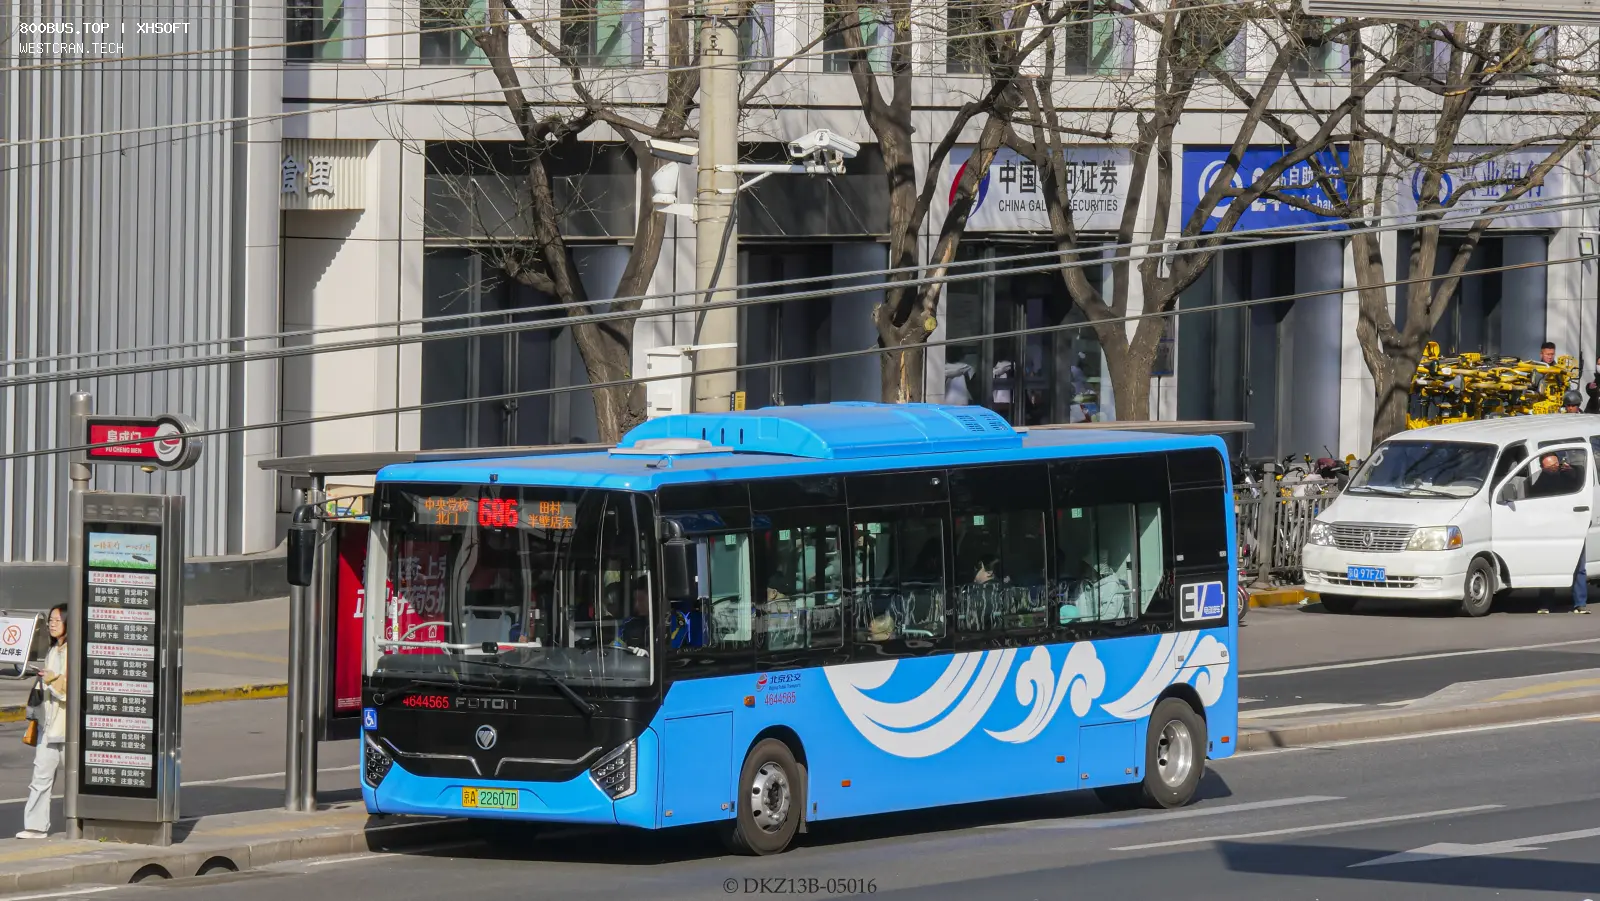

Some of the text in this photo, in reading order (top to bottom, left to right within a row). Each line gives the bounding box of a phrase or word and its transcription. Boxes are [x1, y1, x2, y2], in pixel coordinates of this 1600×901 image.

[998, 199, 1026, 212] CHINA
[425, 497, 561, 527] 中央党校 686 田村
[436, 512, 459, 525] 北门
[769, 673, 801, 684] 北京公交
[403, 696, 449, 709] 4644565
[764, 691, 796, 706] 4644565
